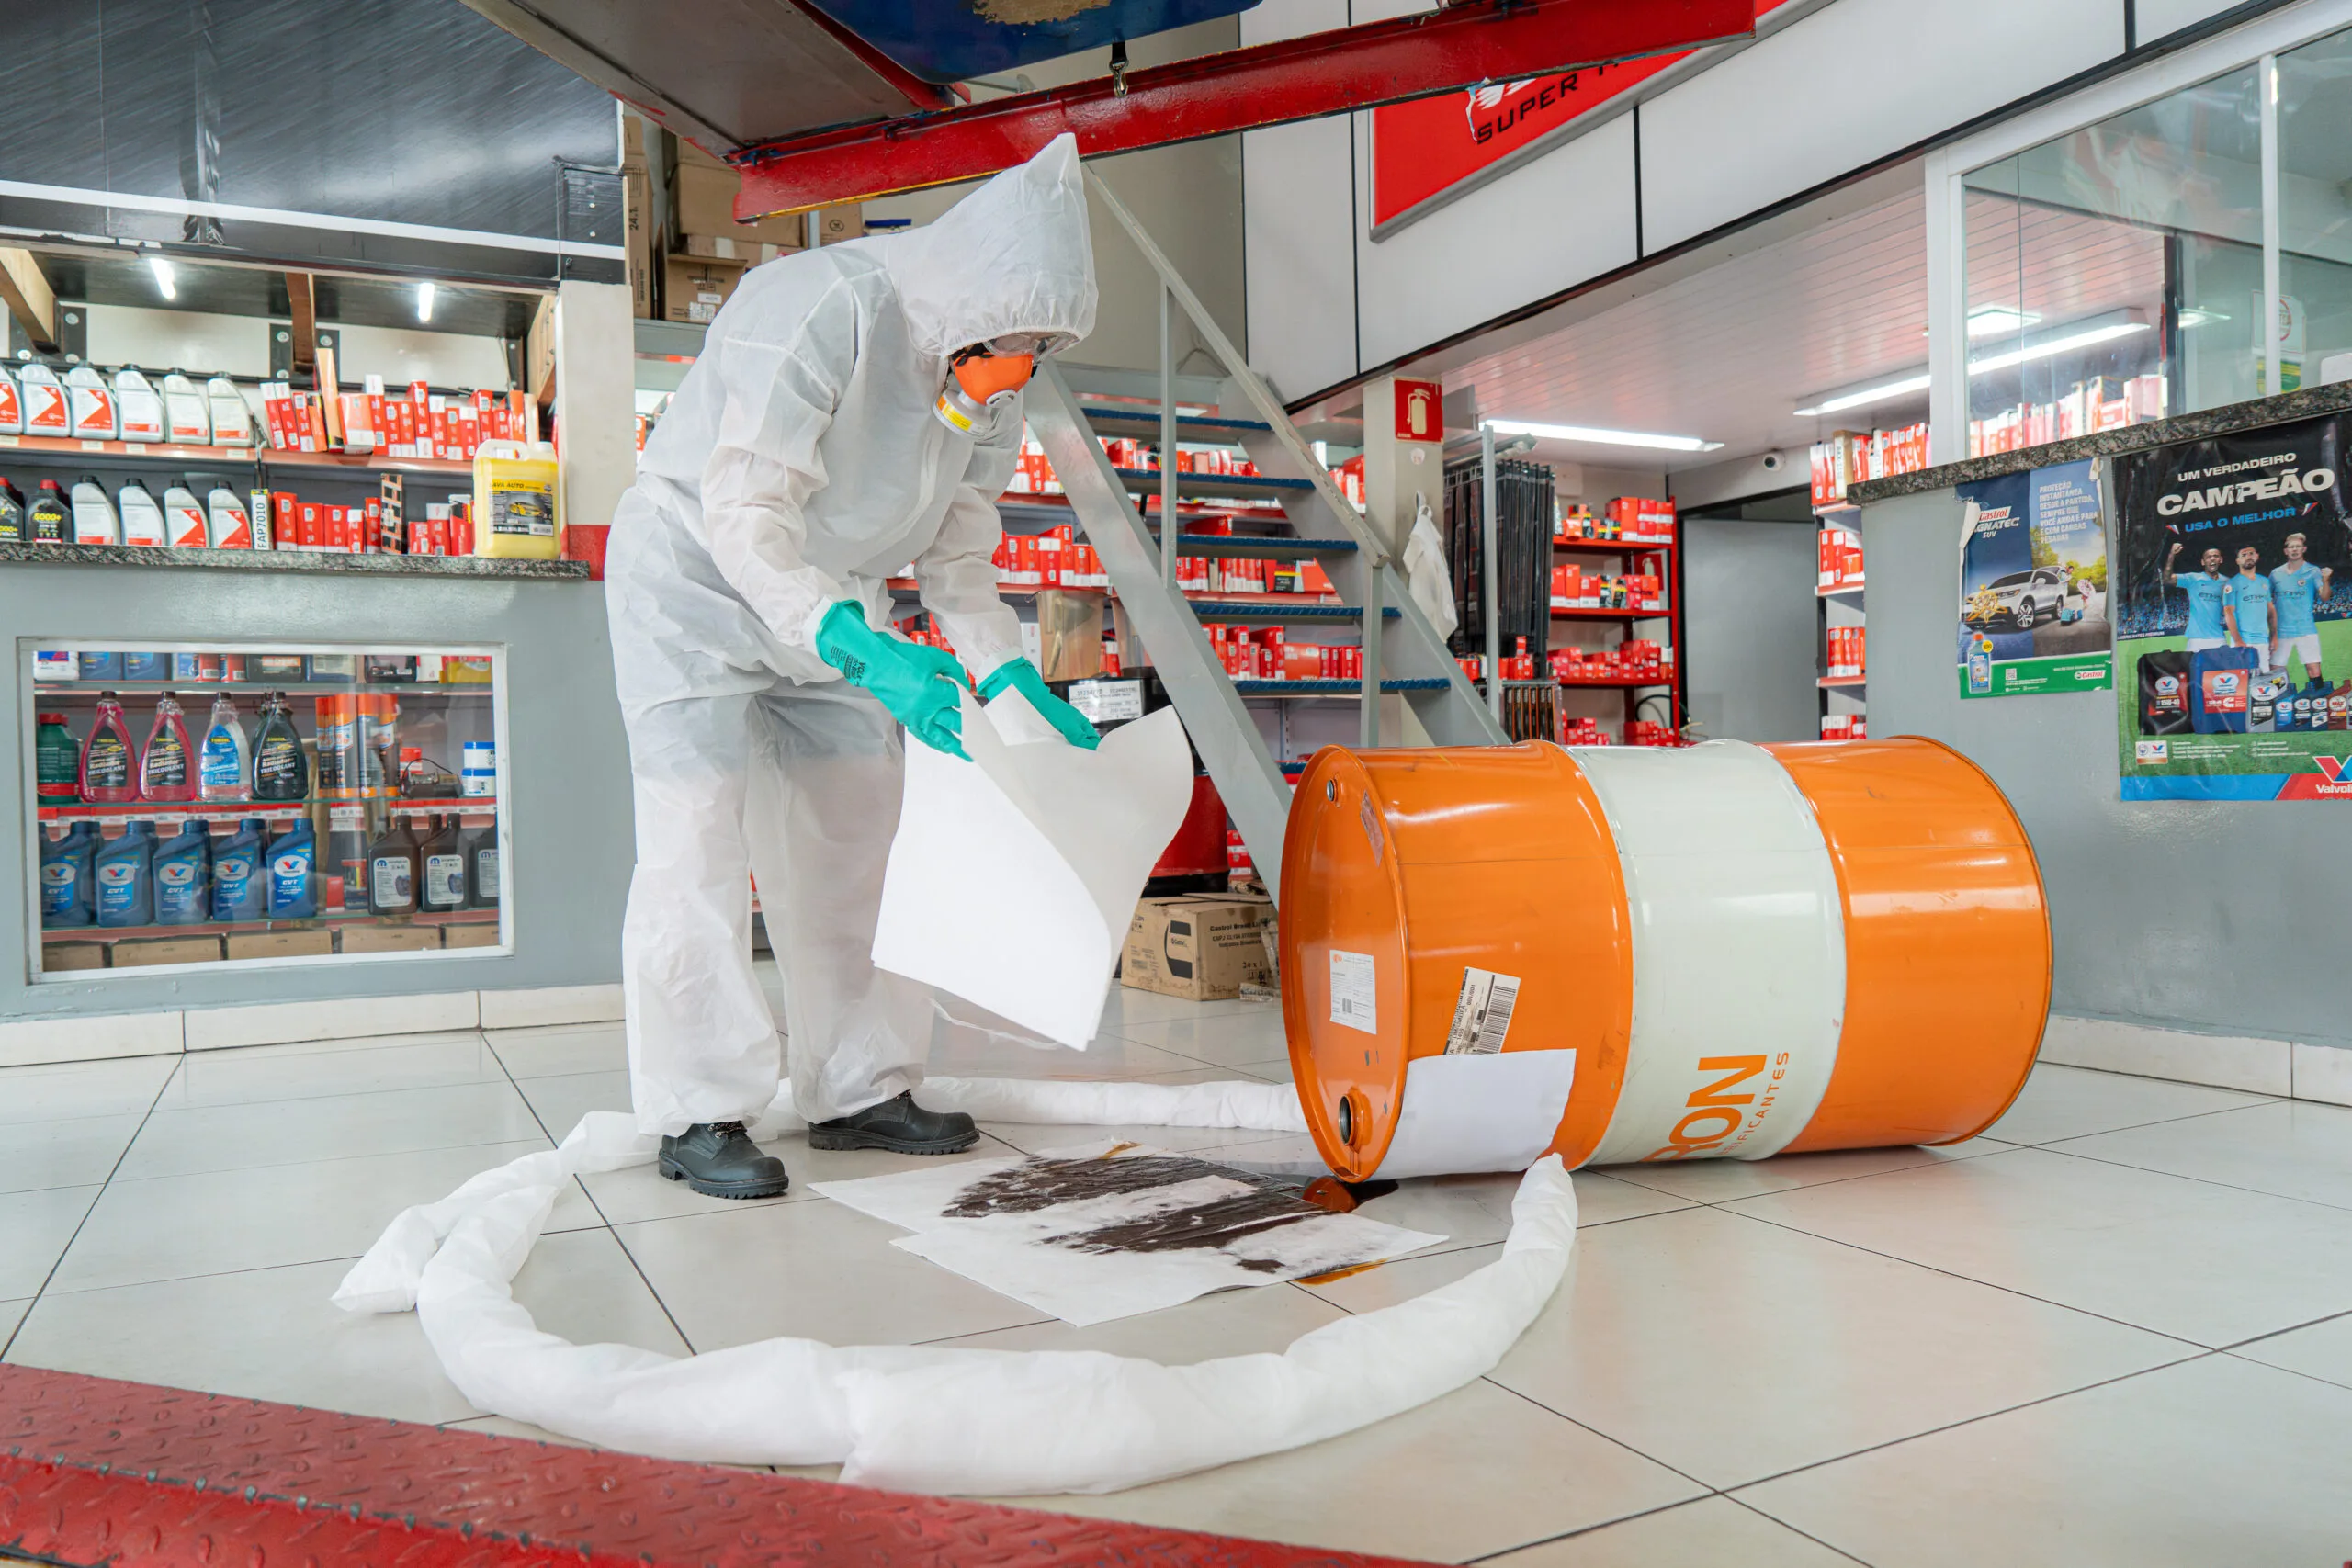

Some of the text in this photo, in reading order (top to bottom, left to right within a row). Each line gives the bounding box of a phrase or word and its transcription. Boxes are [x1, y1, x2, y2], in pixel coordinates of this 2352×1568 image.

[1477, 73, 1578, 145] SUPER
[2177, 452, 2297, 482] UM VERDADEIRO
[2039, 480, 2072, 493] PROTEÇÃO
[2156, 467, 2335, 516] CAMPEÃO
[1979, 507, 2009, 523] Castrol
[2184, 507, 2296, 533] USA O MELHOR
[255, 502, 266, 548] FAP7010
[1974, 517, 2020, 533] GNATEC
[1983, 530, 1997, 539] SUV
[2081, 671, 2104, 679] Castrol
[2315, 784, 2352, 794] Valvoli
